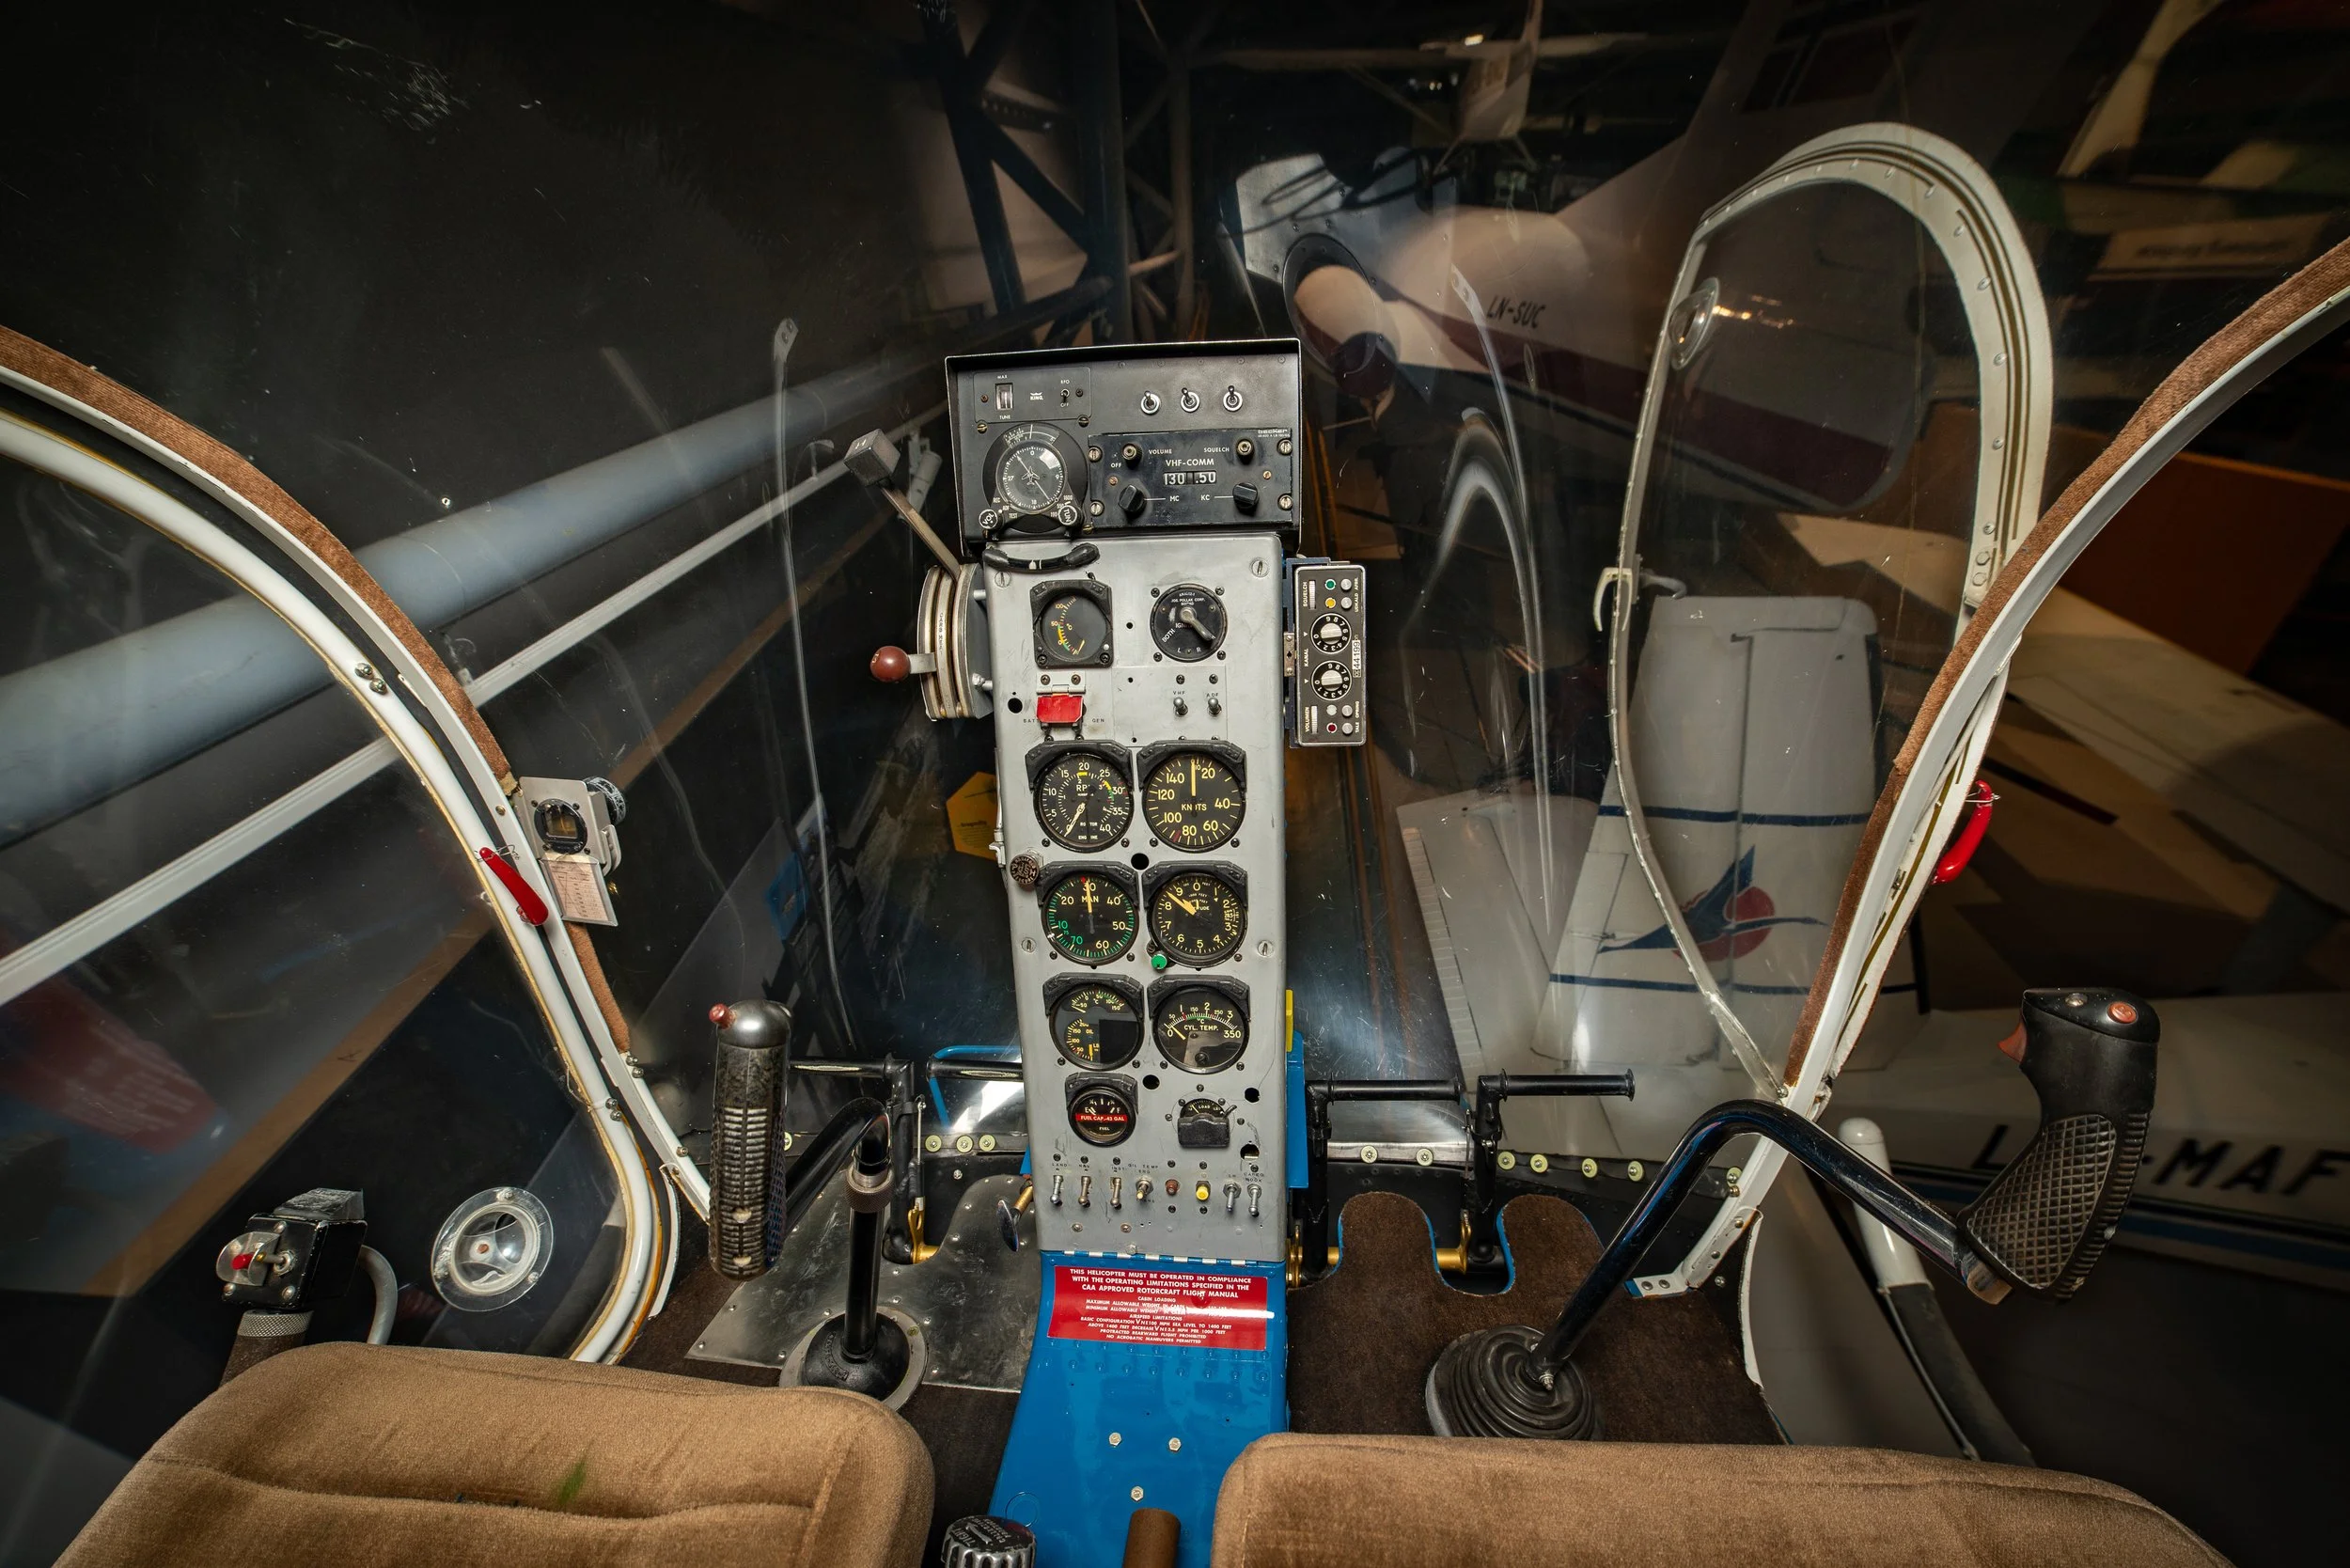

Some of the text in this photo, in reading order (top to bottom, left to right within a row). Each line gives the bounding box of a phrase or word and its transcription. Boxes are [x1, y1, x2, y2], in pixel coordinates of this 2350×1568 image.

[1486, 295, 1546, 329] LN-SUC
[1166, 459, 1214, 467] VHF-COMM
[982, 513, 995, 525] VOL
[1162, 628, 1175, 642] BOTH
[1078, 762, 1089, 771] 20
[1100, 769, 1110, 777] 25
[1201, 768, 1215, 778] 20
[1167, 773, 1184, 784] 140
[1048, 788, 1057, 796] 10
[1157, 789, 1175, 800] 120
[1214, 798, 1230, 808] 40
[1164, 812, 1182, 823] 100
[1100, 823, 1110, 832] 40
[1203, 820, 1218, 831] 60
[1182, 825, 1197, 836] 80
[1193, 882, 1200, 891] 0
[1176, 887, 1183, 896] 9
[1061, 896, 1074, 905] 20
[1106, 896, 1120, 905] 40
[1223, 899, 1230, 908] 2
[1165, 902, 1171, 910] 8
[1058, 920, 1068, 929] 10
[1112, 921, 1126, 930] 50
[1165, 920, 1171, 929] 7
[1225, 922, 1231, 931] 3
[1071, 935, 1083, 945] 70
[1177, 933, 1184, 942] 6
[1213, 934, 1220, 943] 4
[1095, 940, 1109, 949] 60
[1197, 940, 1203, 949] 5
[1204, 1002, 1210, 1011] 2
[1146, 1279, 1189, 1288] LIMITATIONS
[1136, 1287, 1181, 1295] ROTORCRAFT
